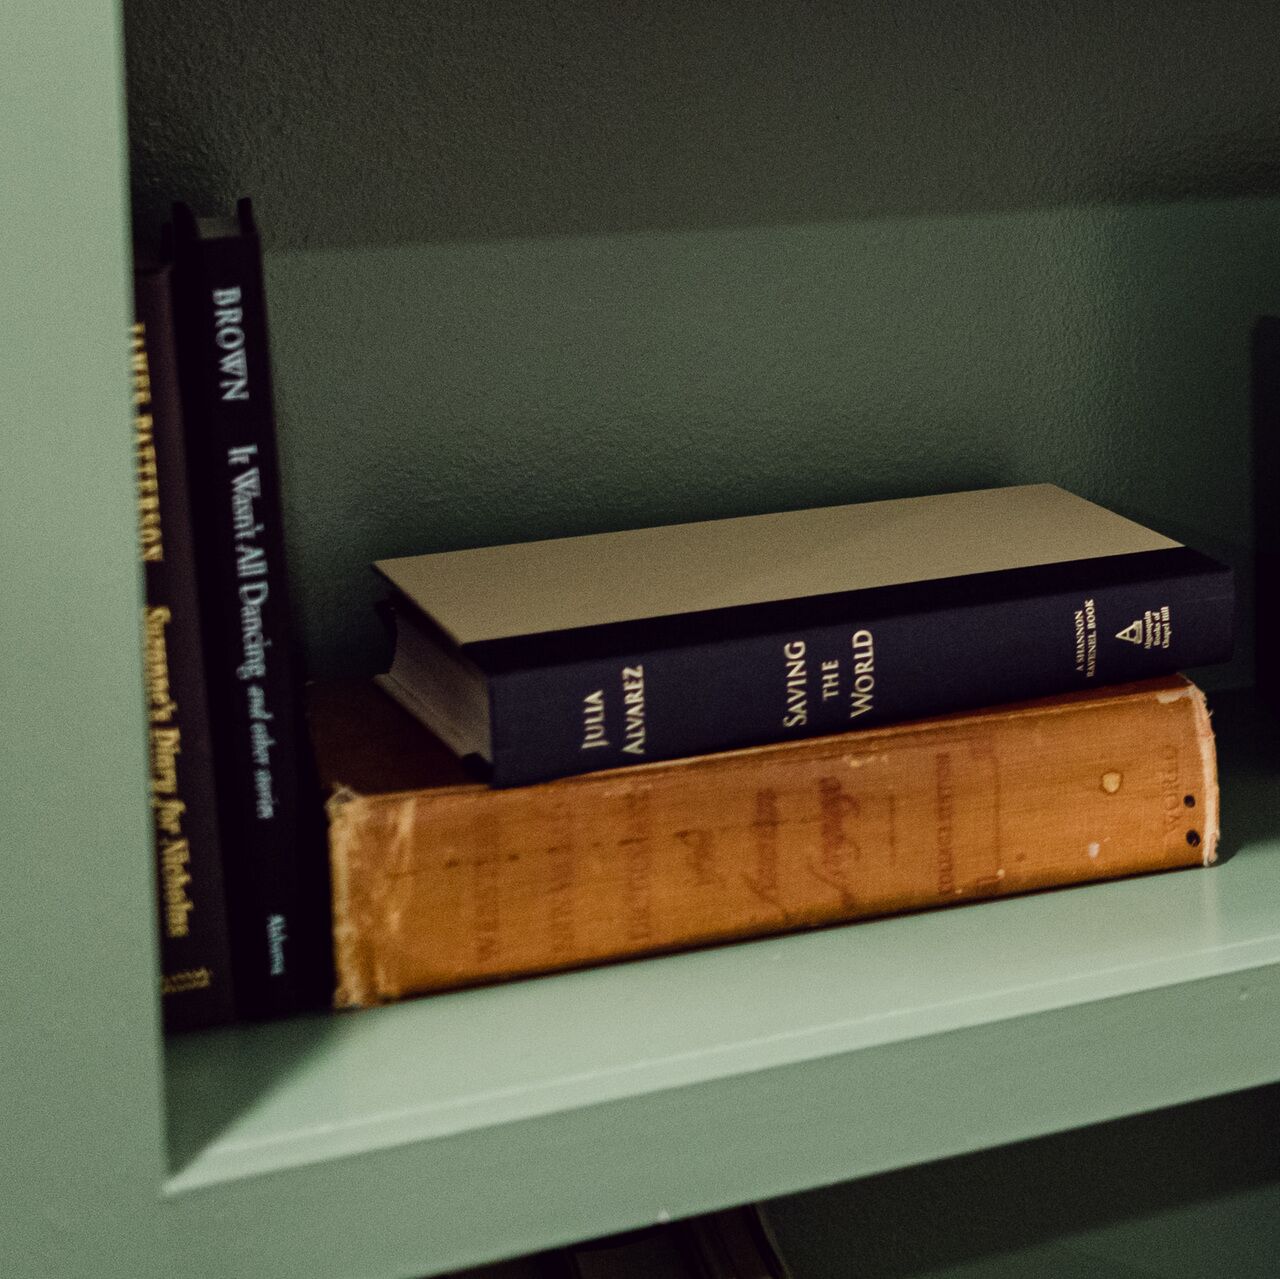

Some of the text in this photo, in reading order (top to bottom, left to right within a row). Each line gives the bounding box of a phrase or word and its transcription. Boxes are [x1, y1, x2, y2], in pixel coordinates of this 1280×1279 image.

[211, 285, 250, 402] BROWN
[234, 542, 269, 578] All
[236, 581, 273, 682] Dancing
[1075, 610, 1085, 663] SHANNON
[1085, 599, 1096, 629] BOOK
[620, 664, 646, 756] ALVAREZ
[782, 640, 807, 729] SAVING
[822, 658, 840, 702] THE
[849, 628, 875, 719] WORLD
[581, 688, 609, 751] JULIA
